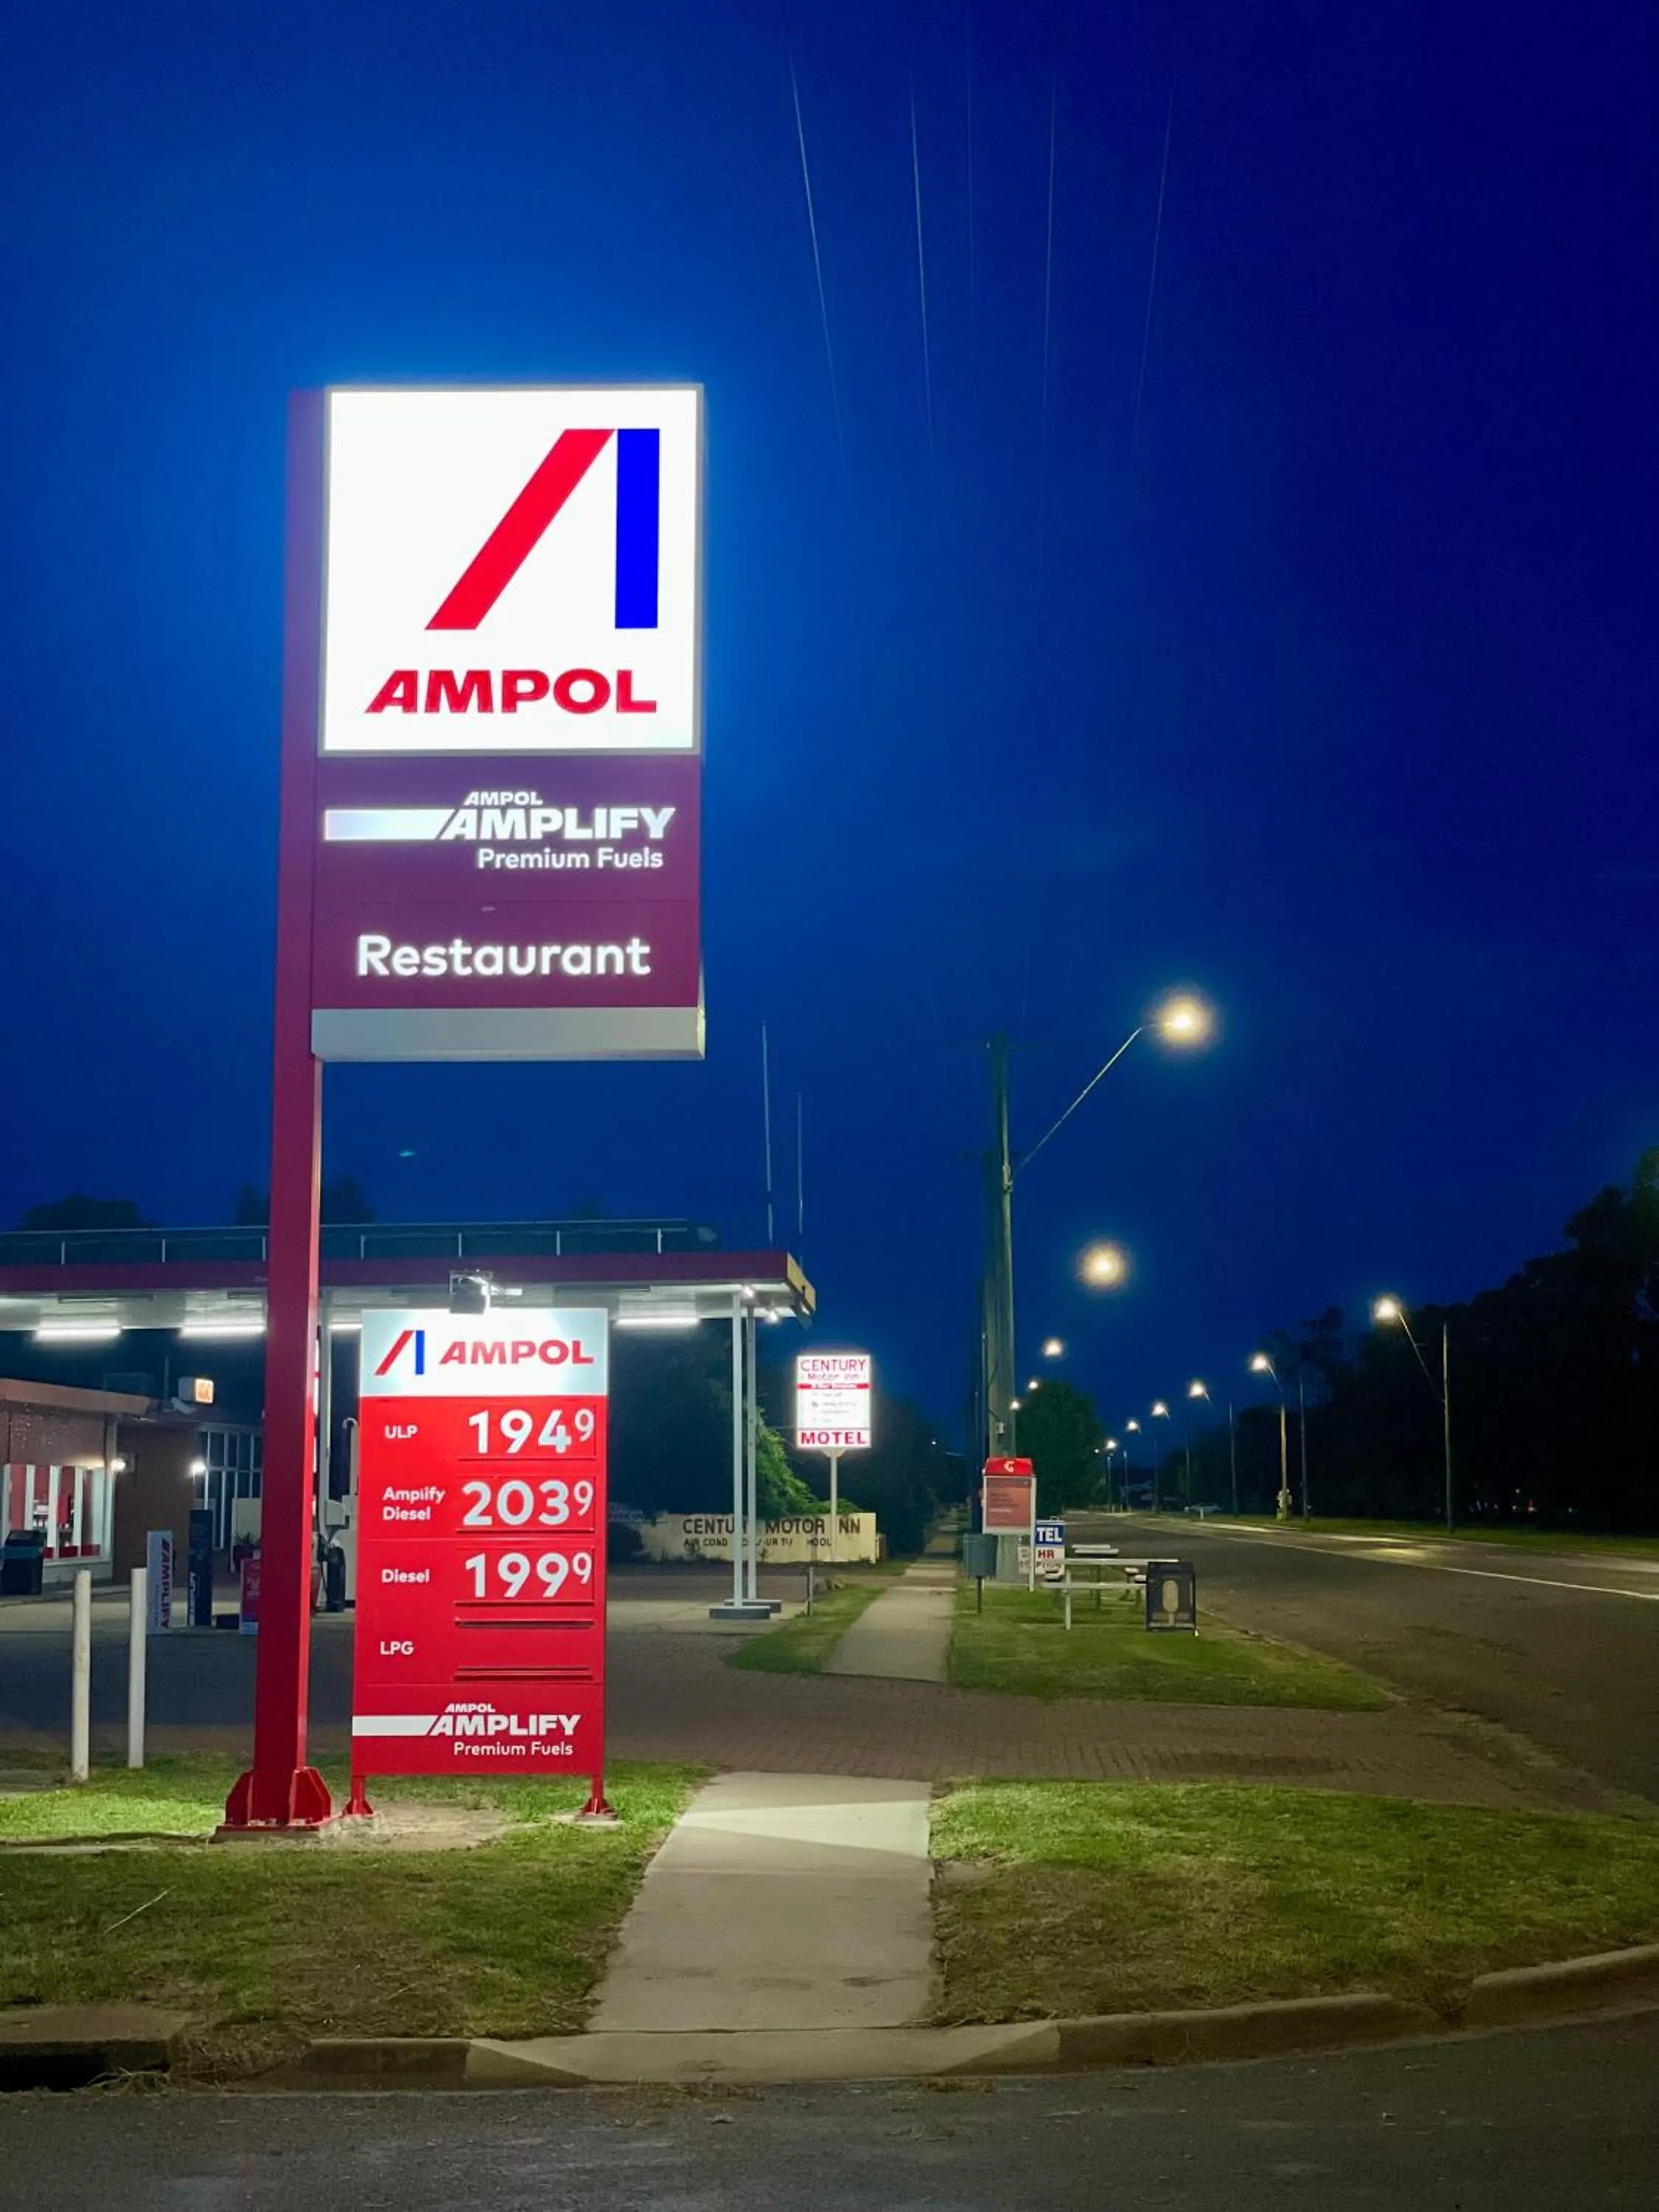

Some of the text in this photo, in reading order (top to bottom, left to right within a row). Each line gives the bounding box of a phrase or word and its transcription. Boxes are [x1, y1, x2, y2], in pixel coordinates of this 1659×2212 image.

[366, 668, 657, 714] AMPOL
[463, 791, 543, 807] AMPOL
[438, 807, 676, 841] AMPLIFY
[477, 846, 664, 870] Premium Fuels
[357, 933, 651, 977] Restaurant
[439, 1340, 594, 1365] AMPOL
[801, 1359, 866, 1371] CENTURY
[384, 1425, 418, 1439] ULP
[801, 1432, 866, 1444] MOTEL
[383, 1486, 445, 1504] Amplify
[383, 1506, 431, 1521] Diesel
[683, 1517, 749, 1534] CENTUY
[765, 1517, 825, 1534] MOTOR
[381, 1568, 431, 1583] Diesel
[380, 1641, 414, 1656] LPG
[445, 1703, 496, 1713] AMPOL
[431, 1715, 581, 1736] AMPLIFY
[453, 1741, 574, 1756] Premium Fuels
